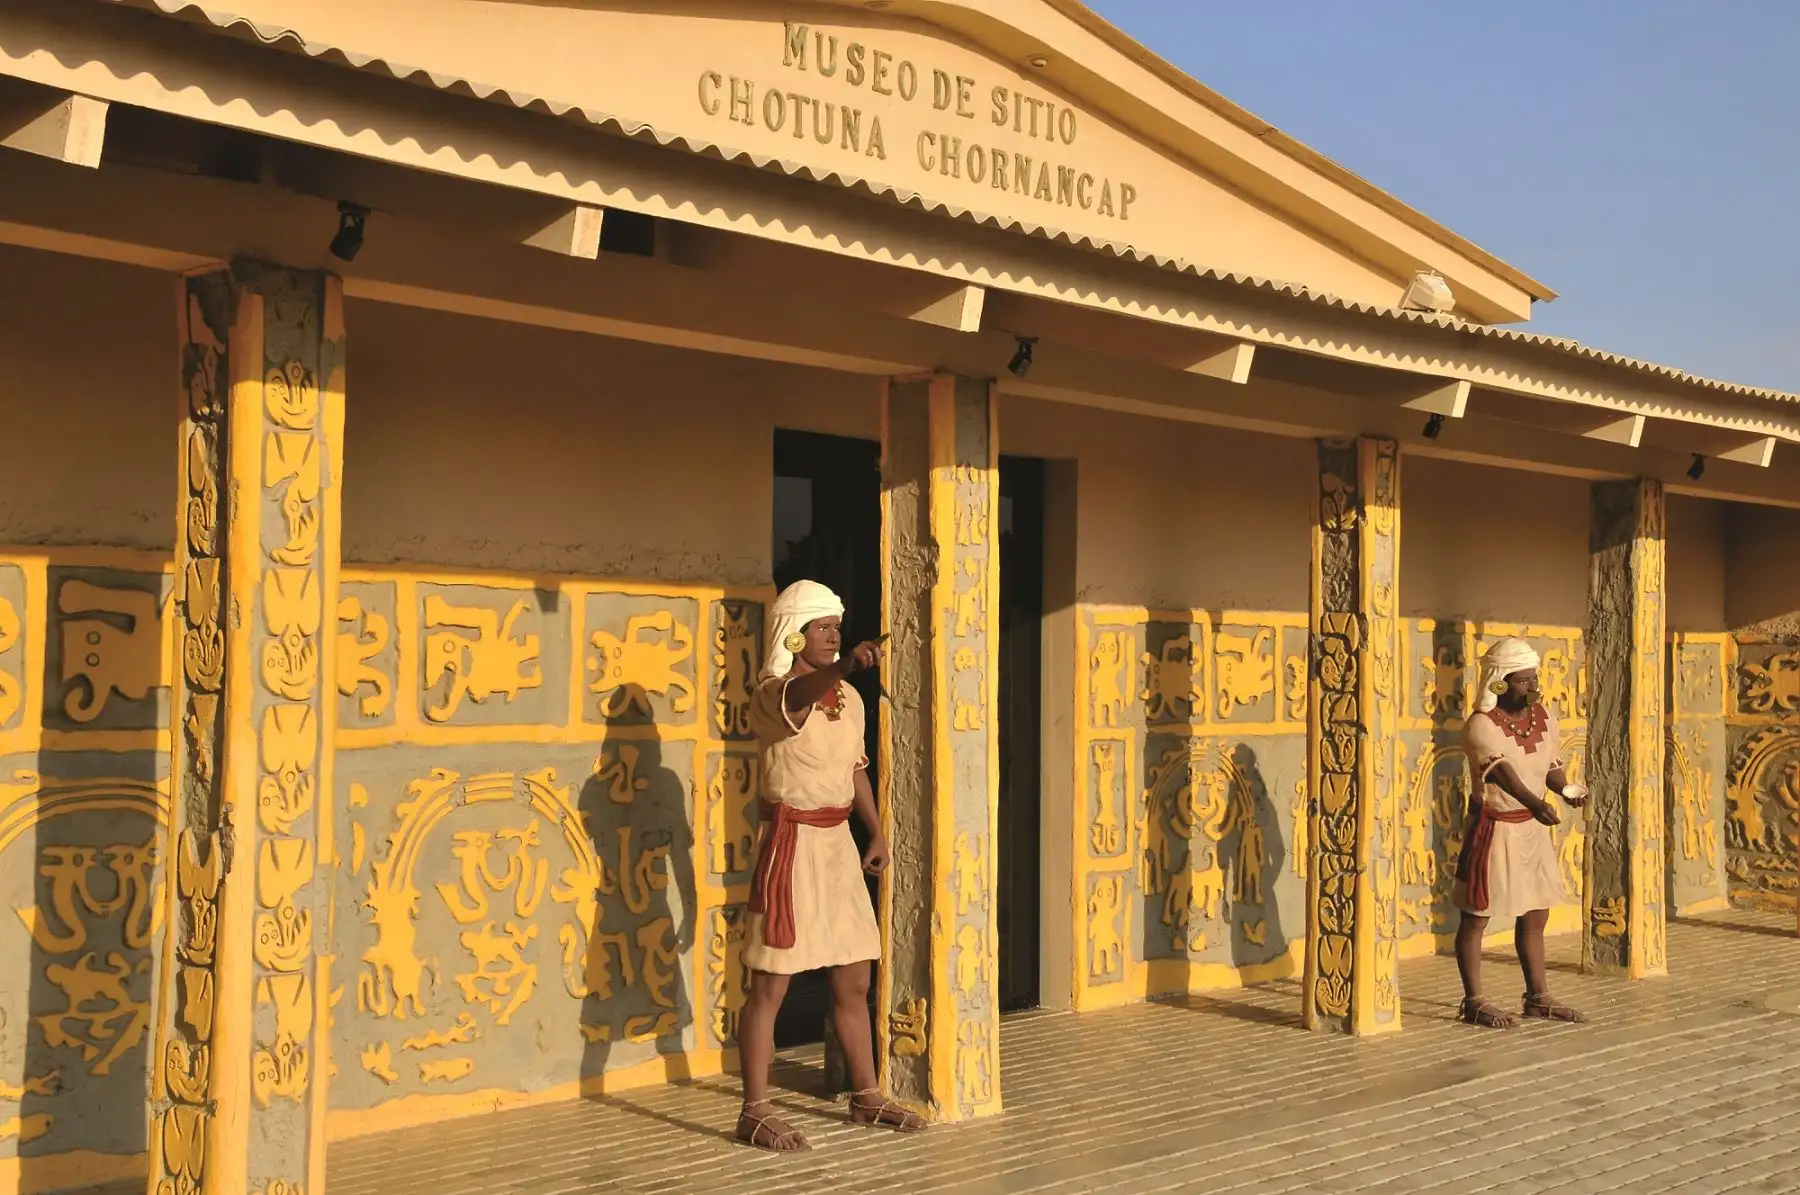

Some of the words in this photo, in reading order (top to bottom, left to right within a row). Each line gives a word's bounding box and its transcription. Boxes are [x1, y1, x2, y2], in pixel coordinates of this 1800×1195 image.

[699, 70, 887, 160] CHOTUNA
[917, 130, 1137, 220] CHORNANCAP
[782, 20, 918, 101] MUSEO
[932, 68, 976, 119] DE
[991, 85, 1077, 145] SITIO
